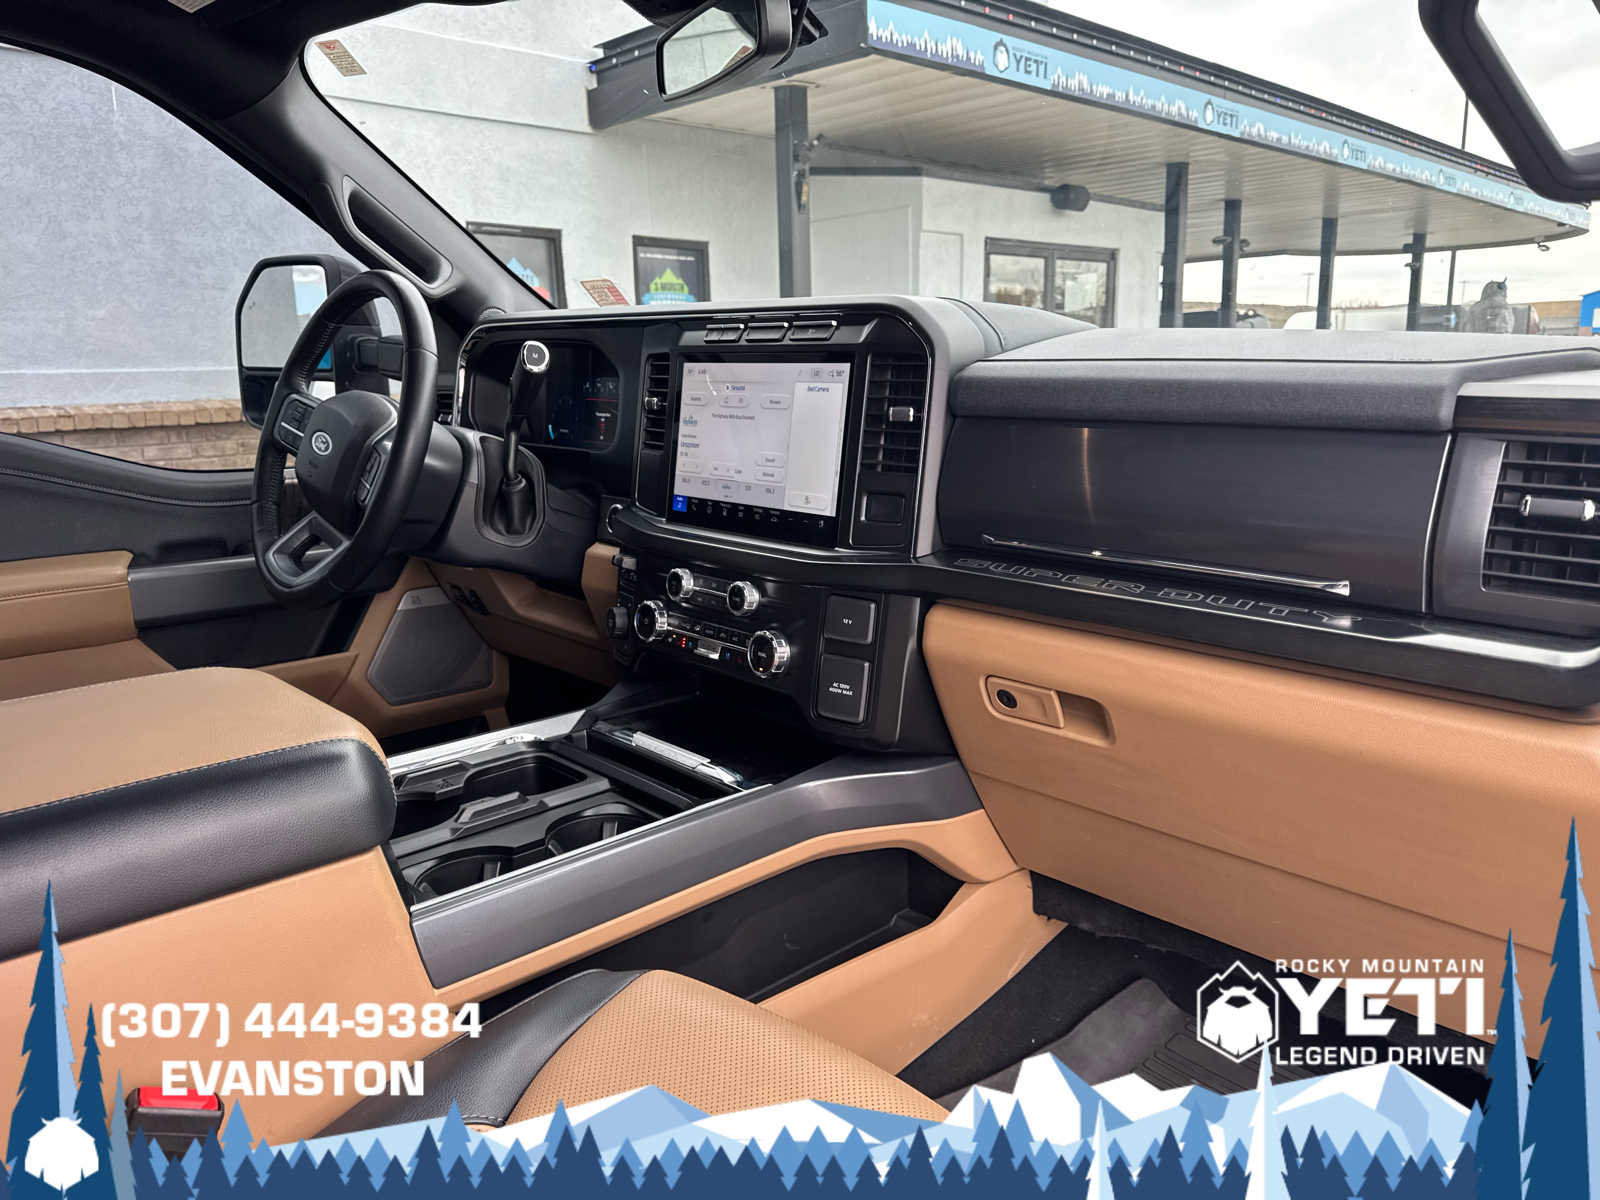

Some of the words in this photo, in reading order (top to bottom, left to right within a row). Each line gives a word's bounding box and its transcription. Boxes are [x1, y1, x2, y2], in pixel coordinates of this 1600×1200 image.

[1012, 52, 1048, 79] YETI
[1215, 109, 1240, 129] YETI
[955, 558, 1145, 594] SUPER
[1157, 588, 1362, 626] DUTY
